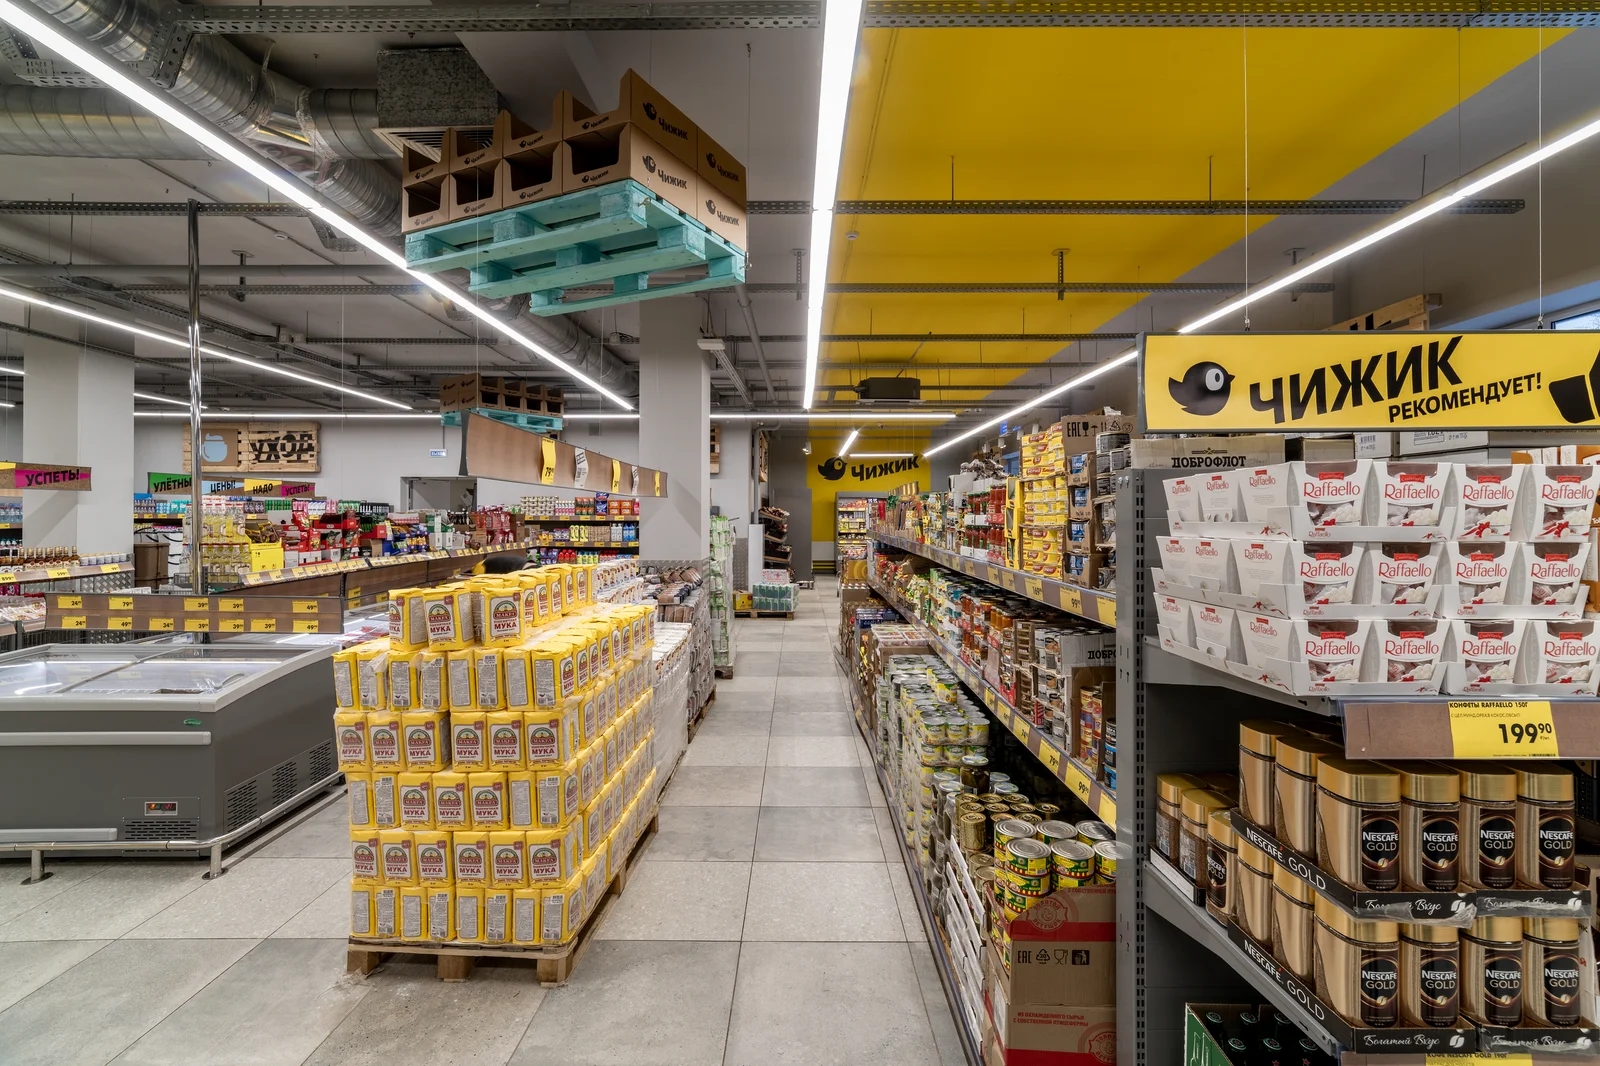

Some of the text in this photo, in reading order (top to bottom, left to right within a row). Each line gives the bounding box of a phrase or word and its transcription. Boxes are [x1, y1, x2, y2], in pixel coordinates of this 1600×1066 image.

[658, 117, 688, 141] Чижик
[658, 168, 688, 190] Чижик
[1249, 336, 1464, 424] ЧИЖИК
[1388, 372, 1542, 422] РЕКОМЕНДУЕТ!
[1171, 456, 1246, 468] ДОБРОФЛОТ
[25, 468, 80, 487] УСПЕТЬ!
[153, 476, 192, 492] УЛЁТНЫ
[1206, 480, 1230, 490] Raffaello
[1249, 476, 1276, 487] Raffaello
[210, 480, 236, 494] ЦЕНЫ!
[252, 483, 274, 494] НАДО
[285, 484, 310, 496] УСПЕТЬ!
[1304, 481, 1360, 498] Raffaello
[1384, 484, 1440, 500] Raffaello
[1463, 484, 1514, 502] Raffaello
[1542, 484, 1594, 501] Raffaello
[1196, 546, 1218, 556] Raffaello
[1244, 548, 1272, 560] Raffaello
[1300, 562, 1354, 578] Raffaello
[1378, 562, 1432, 578] Raffaello
[1456, 562, 1508, 578] Raffaello
[1530, 563, 1580, 579] Raffaello
[1200, 610, 1222, 624] Raffaello
[494, 622, 517, 630] МУКА
[1250, 621, 1278, 636] Raffaello
[1306, 640, 1360, 657] Raffaello
[1385, 640, 1440, 656] Raffaello
[1462, 640, 1516, 656] Raffaello
[1544, 641, 1596, 658] Raffaello
[1366, 842, 1397, 852] GOLD
[1427, 842, 1457, 852] GOLD
[1484, 840, 1514, 850] GOLD
[1544, 840, 1572, 850] GOLD
[1288, 856, 1326, 890] GOLD
[1415, 899, 1442, 916] Вкус
[1366, 980, 1396, 990] GOLD
[1425, 980, 1456, 990] GOLD
[1490, 980, 1520, 989] GOLD
[1549, 978, 1578, 988] GOLD
[1287, 980, 1325, 1020] GOLD
[1024, 1012, 1066, 1020] ОХЛАЖДЕННОГО
[1363, 1034, 1440, 1050] Богатый Вкус
